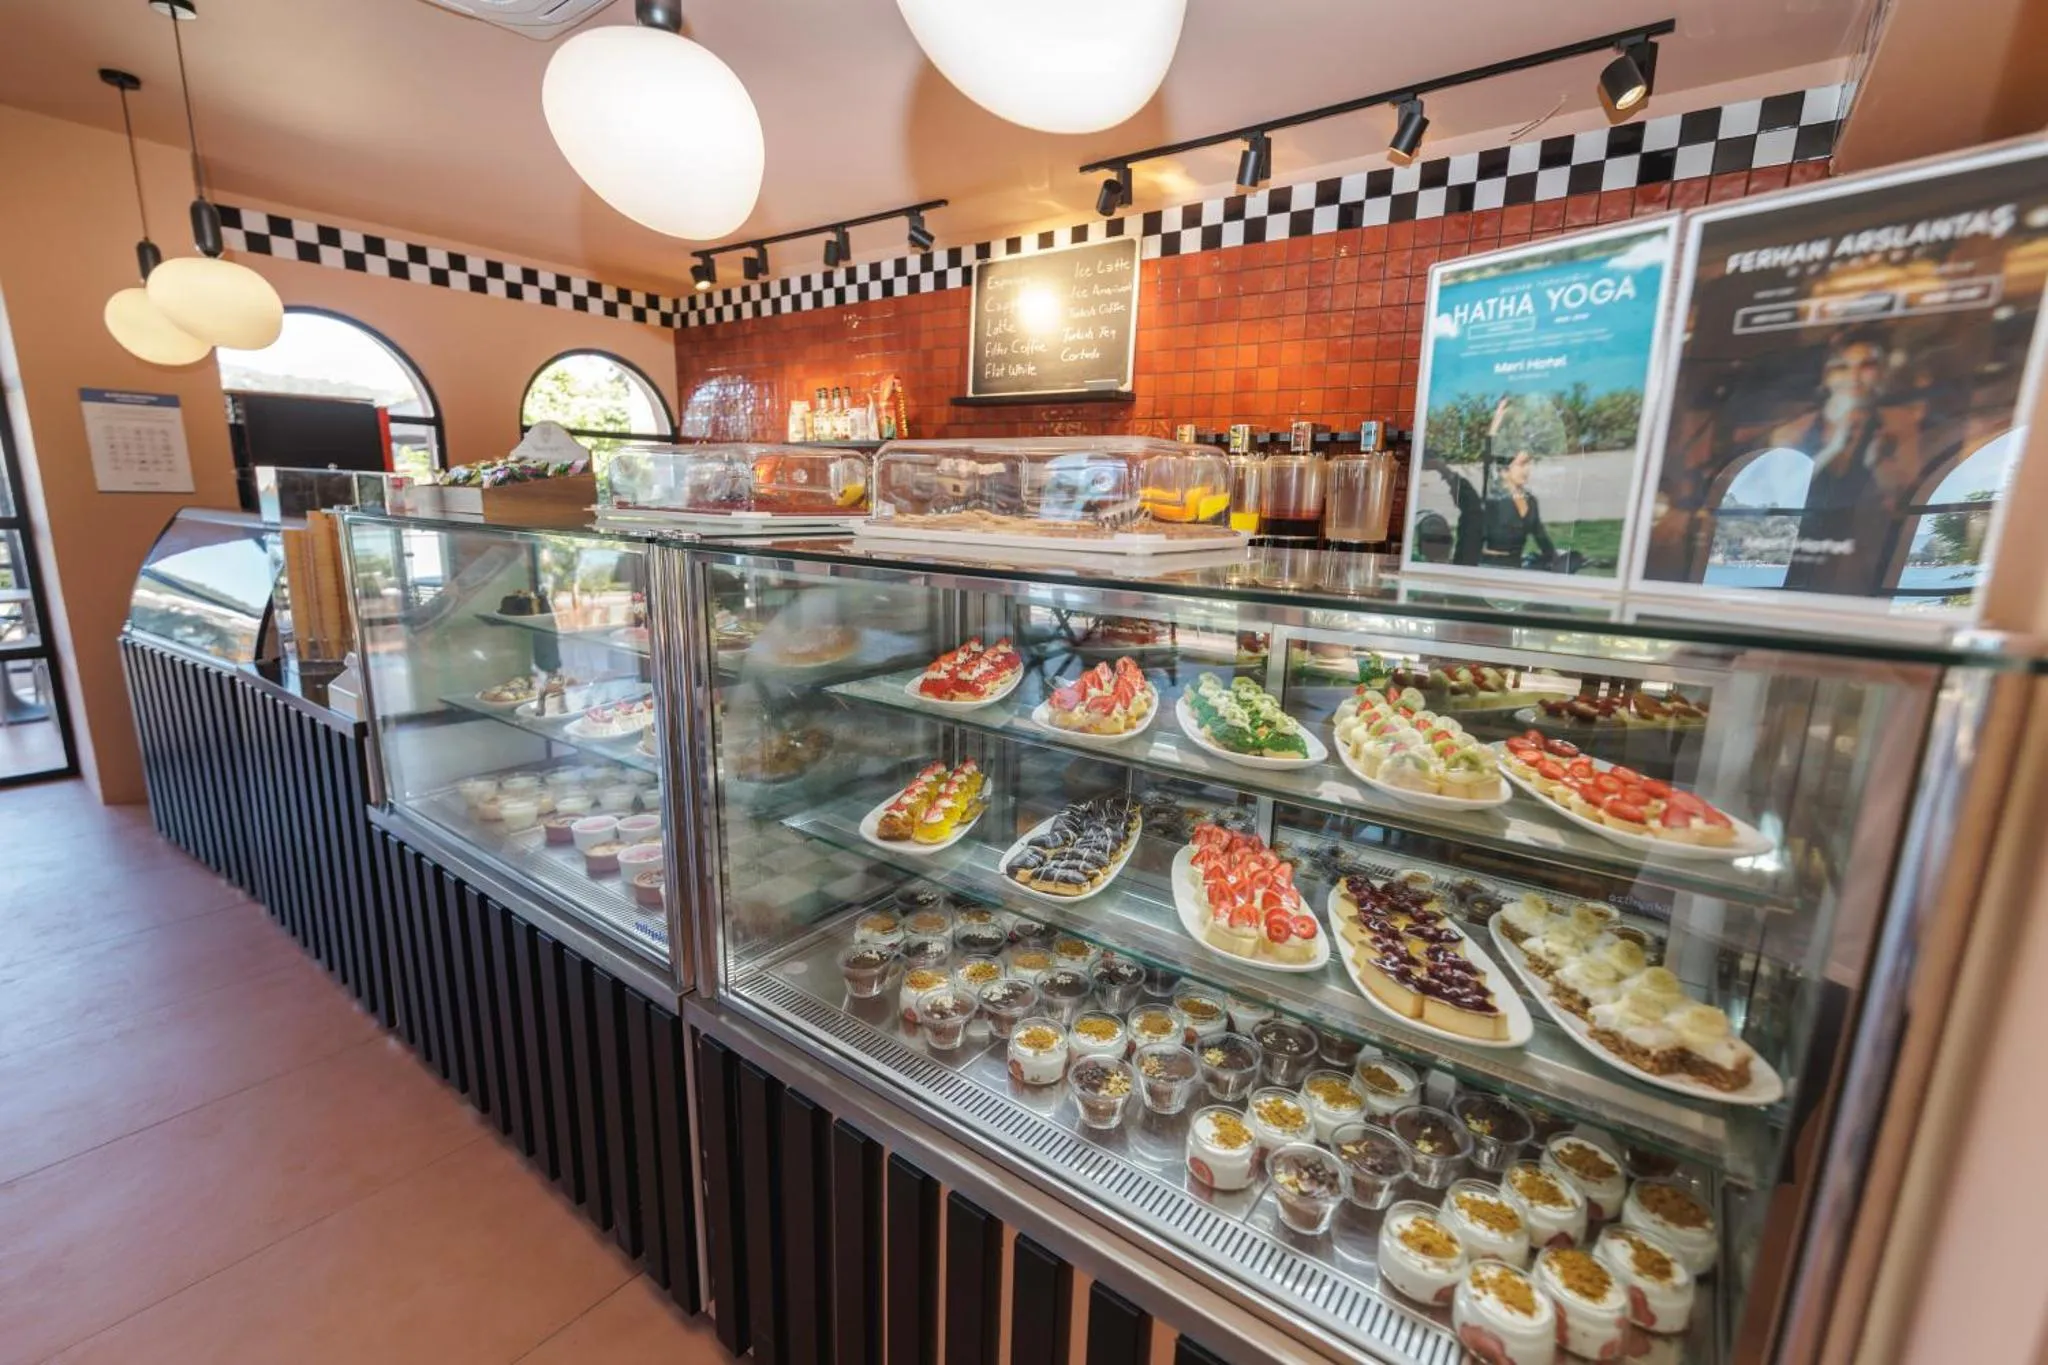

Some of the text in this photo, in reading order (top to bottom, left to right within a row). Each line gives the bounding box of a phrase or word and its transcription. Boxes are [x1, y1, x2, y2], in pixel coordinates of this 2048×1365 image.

[1725, 237, 1832, 275] FERHAN
[1074, 258, 1131, 279] Ice Latte
[1453, 291, 1535, 326] HATHA
[1546, 274, 1637, 312] YOGA
[986, 318, 1017, 337] Latte
[1010, 338, 1049, 357] Coffee
[984, 360, 1038, 380] Flat White
